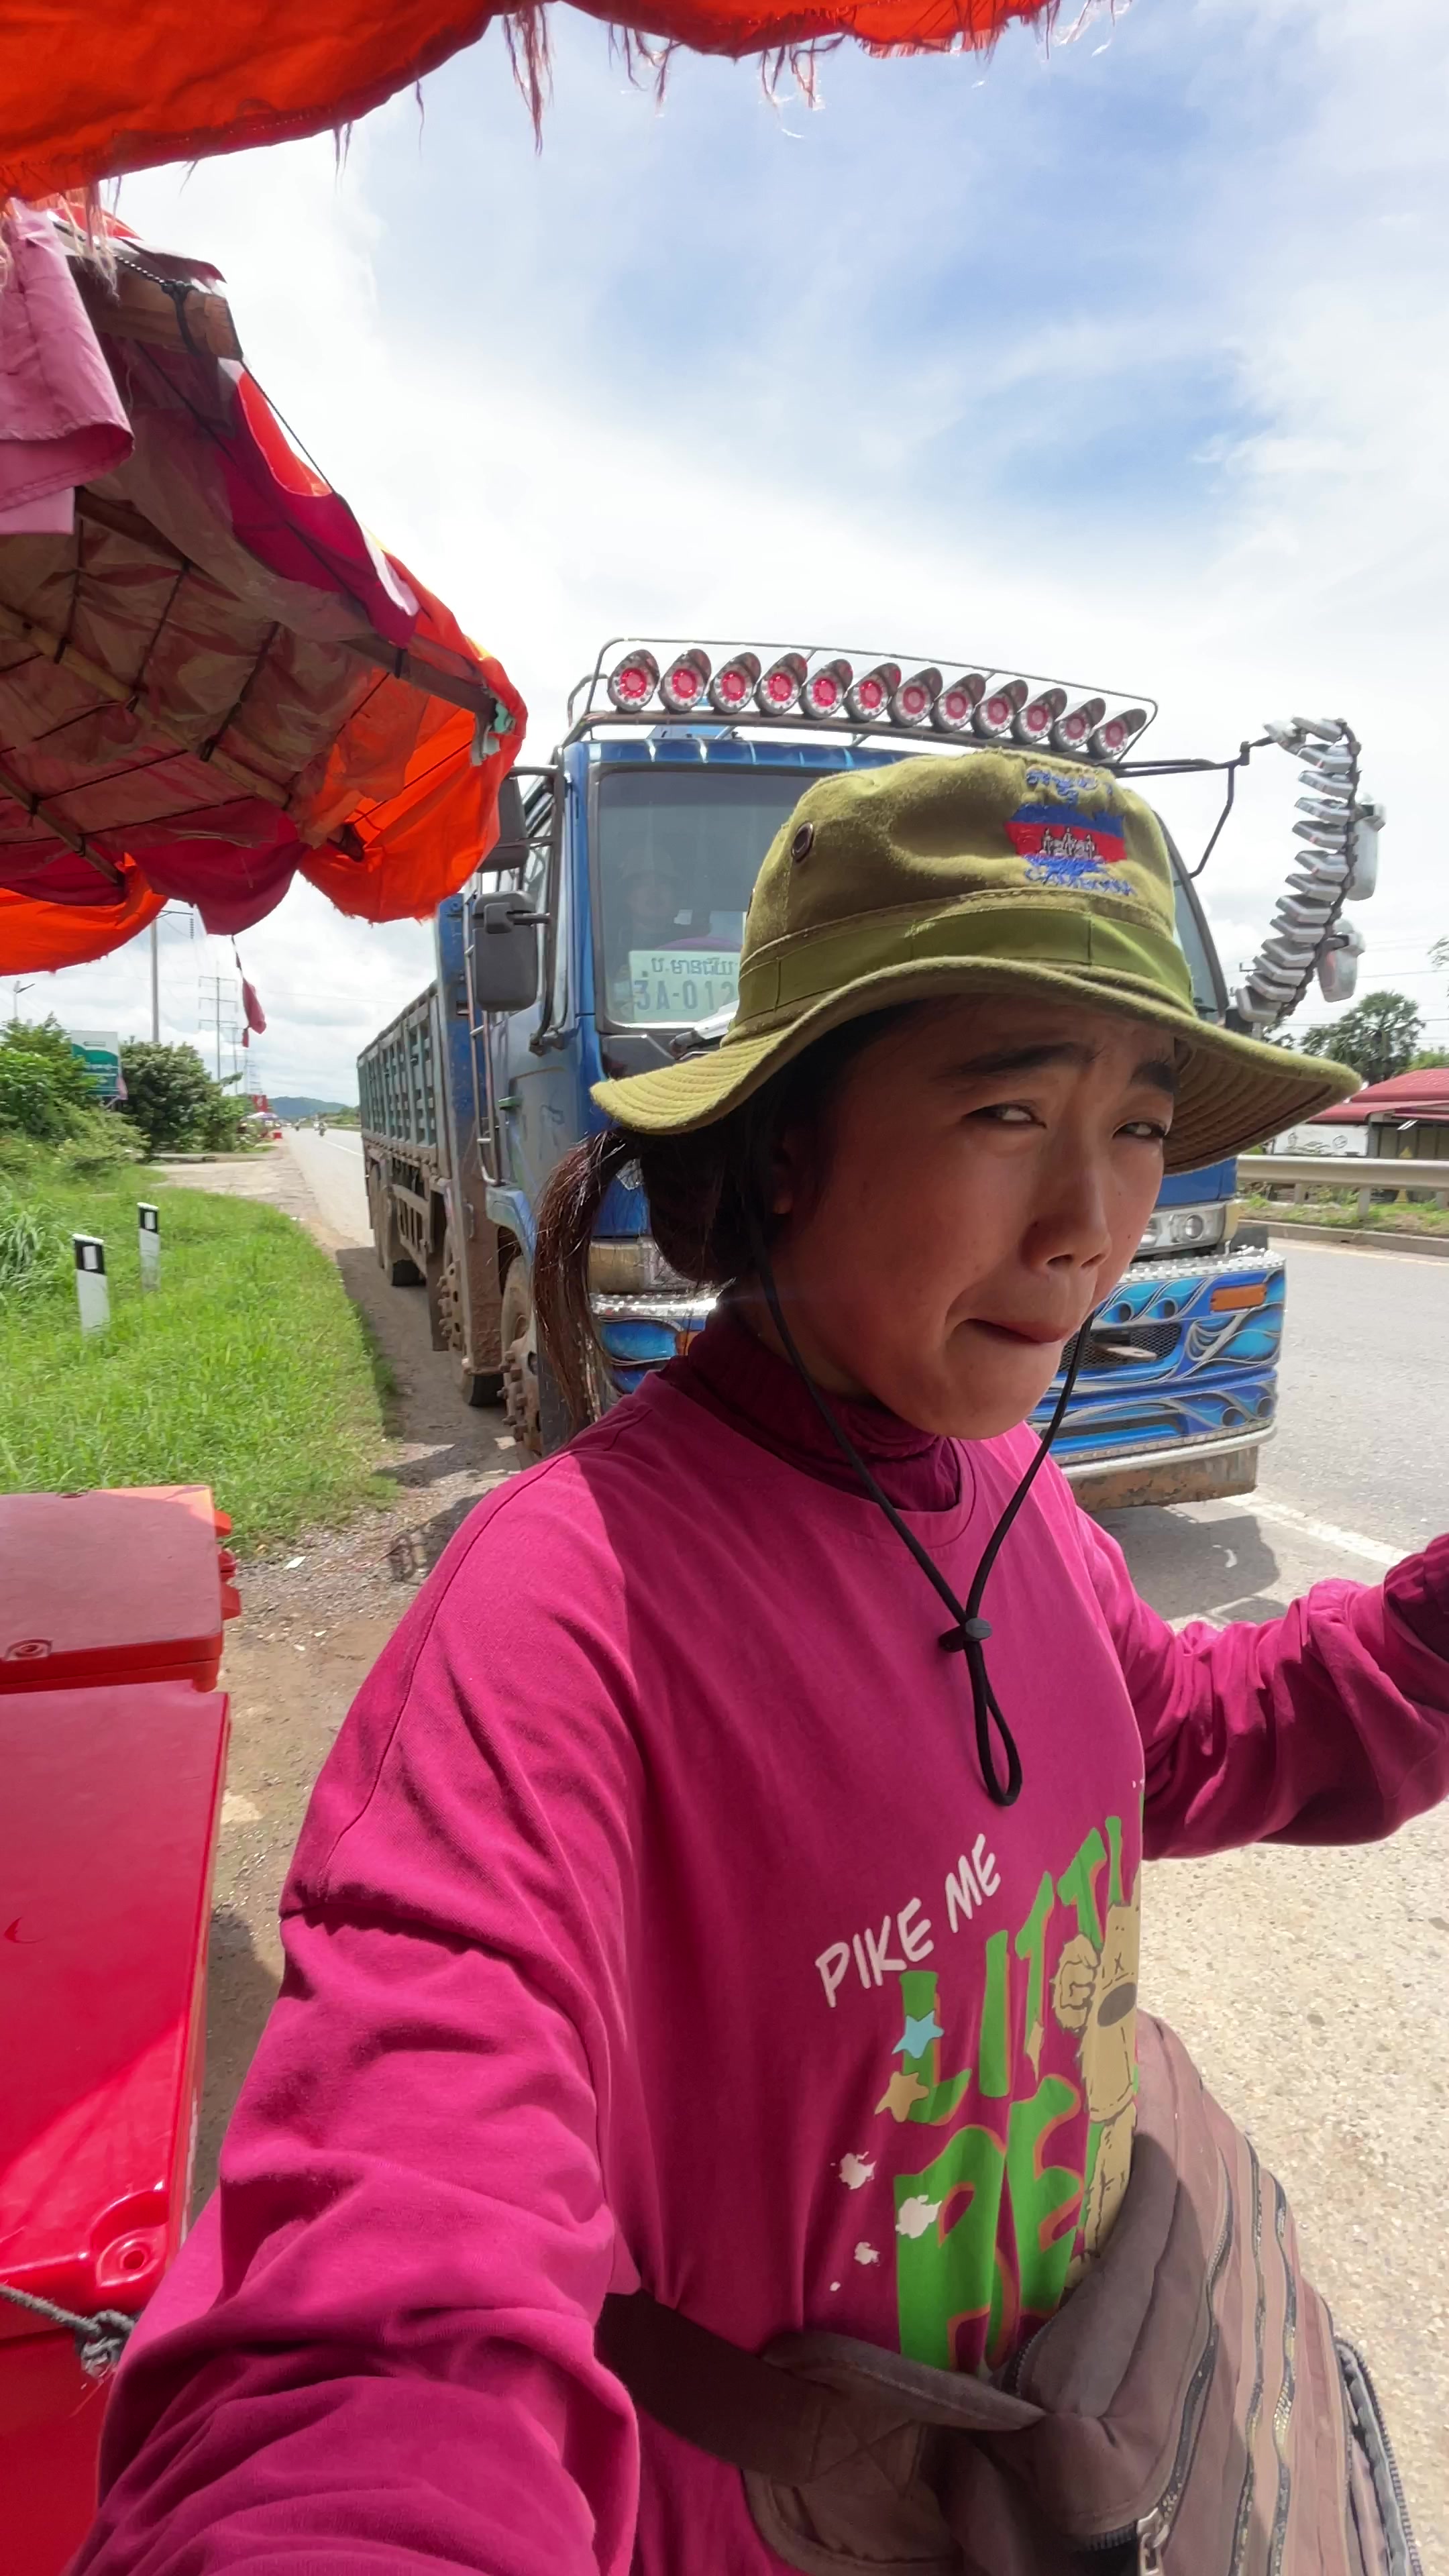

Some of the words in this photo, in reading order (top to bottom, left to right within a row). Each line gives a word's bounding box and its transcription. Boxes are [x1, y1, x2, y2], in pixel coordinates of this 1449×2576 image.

[634, 979, 735, 1010] 3A-012
[815, 1897, 936, 2008] PIKE
[945, 1833, 1002, 1933] ME
